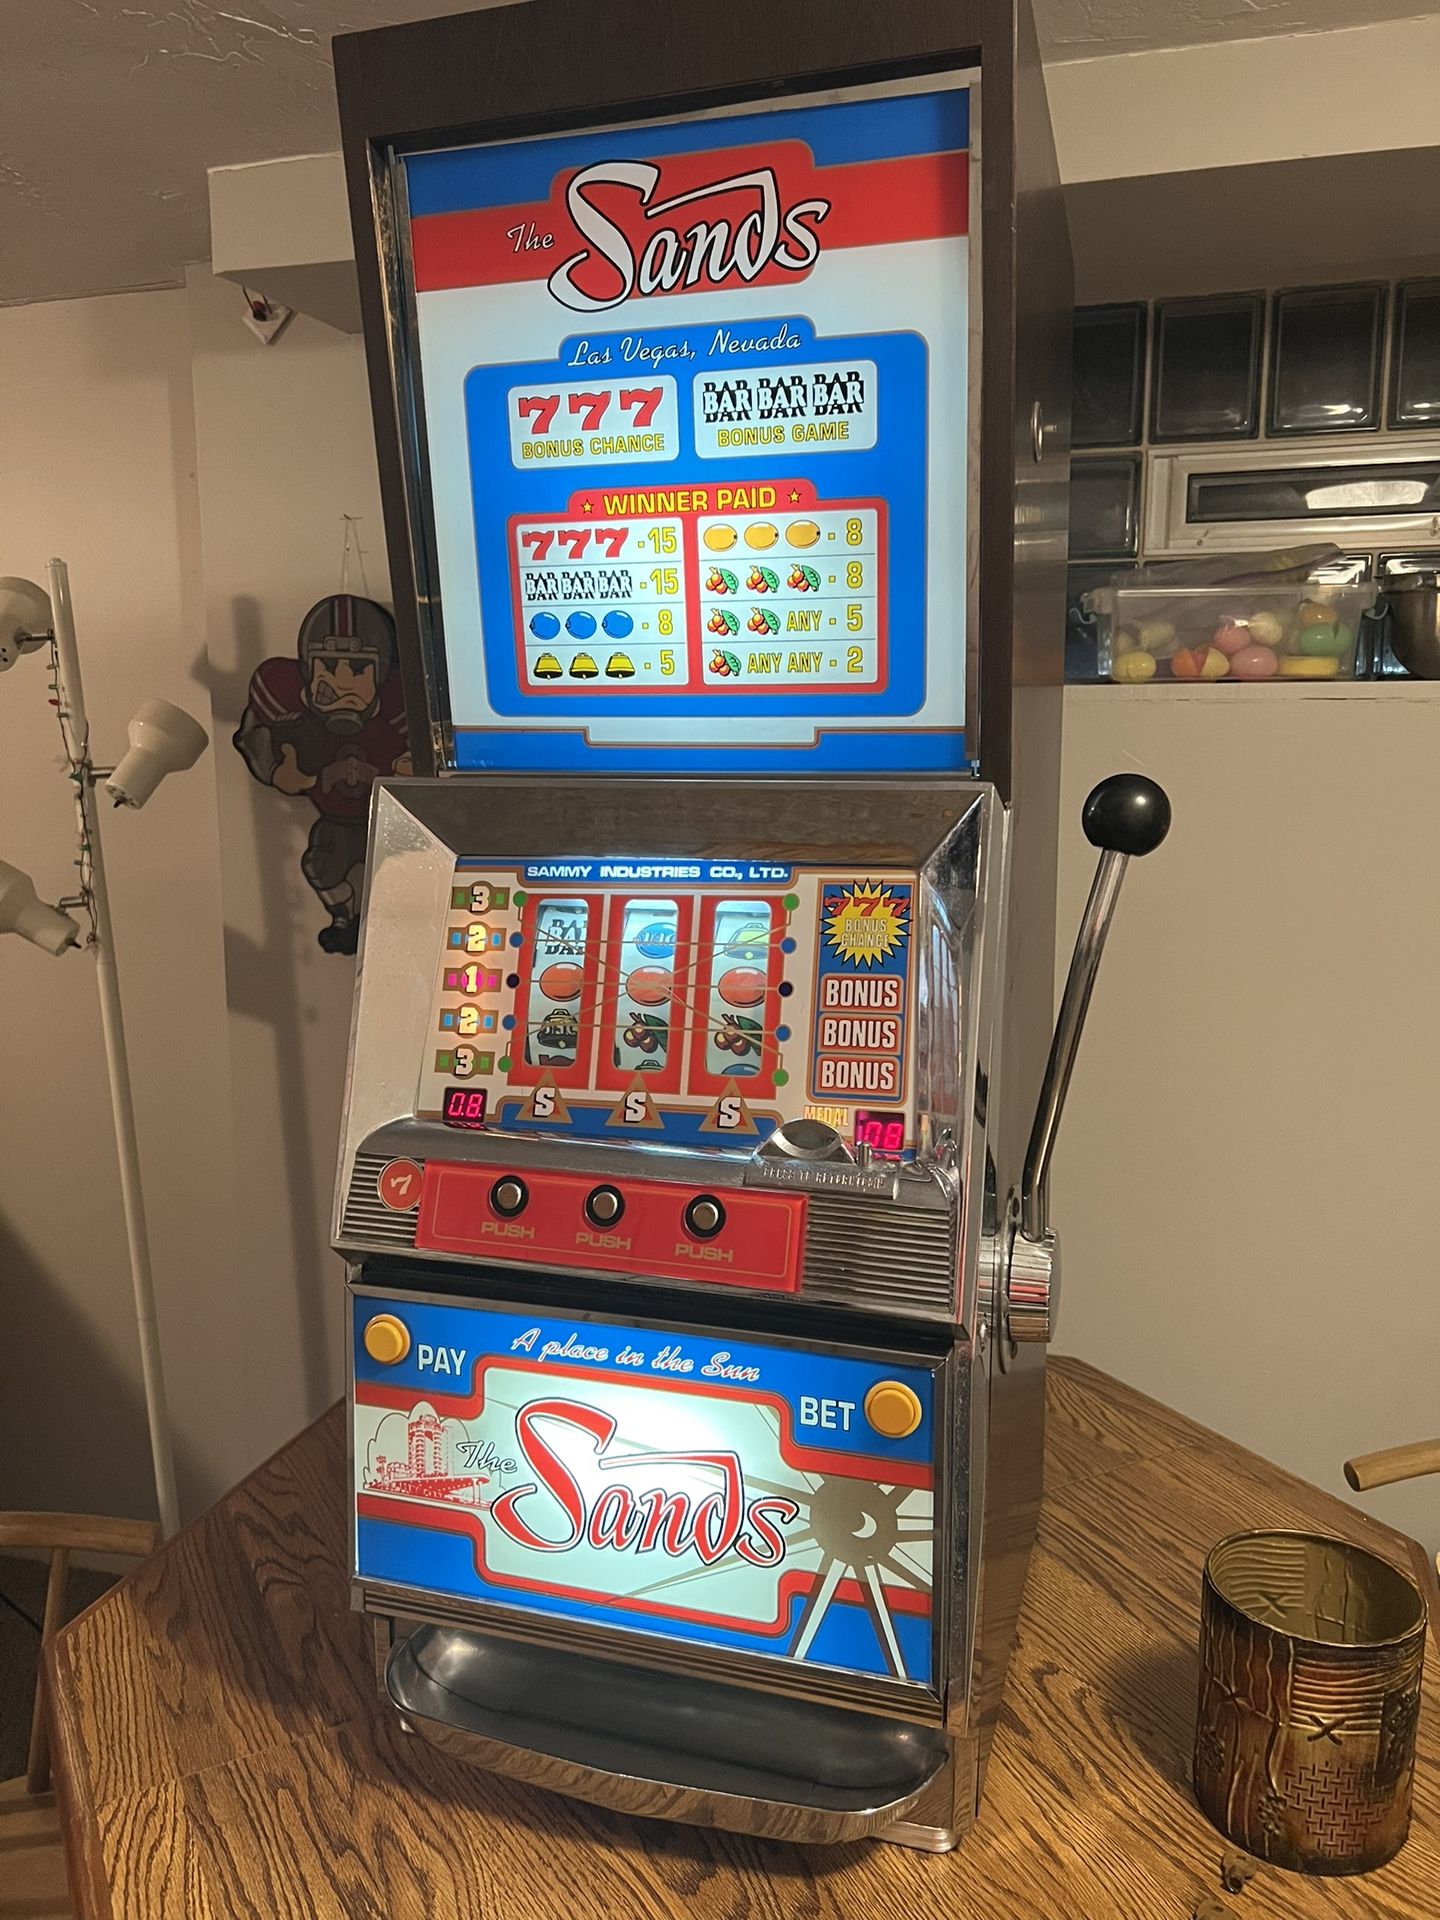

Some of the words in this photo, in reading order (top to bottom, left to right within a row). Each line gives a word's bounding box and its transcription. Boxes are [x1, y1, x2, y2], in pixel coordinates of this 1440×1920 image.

[507, 223, 554, 253] The
[547, 160, 831, 312] Sands
[567, 339, 613, 367] Las
[620, 335, 697, 368] Vegas,
[708, 324, 801, 357] Nevada
[703, 385, 752, 415] BAR
[757, 380, 808, 412] BAR
[812, 377, 865, 409] BAR
[521, 439, 584, 459] BONUS
[590, 433, 665, 455] CHANCE
[717, 426, 785, 447] BONUS
[791, 421, 849, 442] GAME
[603, 490, 708, 515] WINNER
[717, 486, 776, 510] PAID
[846, 518, 863, 546] 8
[847, 561, 863, 589] 8
[658, 609, 673, 635] 8
[786, 610, 822, 631] ANY
[847, 604, 863, 631] 5
[660, 650, 675, 676] 5
[747, 653, 782, 673] ANY
[787, 652, 823, 672] ANY
[847, 646, 863, 673] 2
[527, 866, 592, 878] SAMMY
[600, 866, 700, 878] INDUSTRIES
[749, 866, 788, 878] LTD.
[471, 885, 490, 913] 3
[466, 924, 486, 952] 2
[845, 918, 887, 933] BONUS
[841, 933, 888, 948] CHANCE
[465, 965, 478, 993] 1
[826, 979, 897, 1007] BONUS
[459, 1007, 479, 1035] 2
[824, 1019, 895, 1048] BONUS
[455, 1048, 474, 1076] 3
[821, 1060, 894, 1090] BONUS
[533, 1087, 555, 1117] S
[624, 1092, 646, 1123] S
[717, 1097, 741, 1129] S
[804, 1106, 848, 1126] MEDAL
[391, 1174, 412, 1195] 7
[481, 1221, 535, 1239] PUSH
[576, 1232, 631, 1250] PUSH
[675, 1243, 733, 1263] PUSH
[417, 1343, 466, 1376] PAY
[511, 1328, 541, 1351] A
[538, 1333, 609, 1362] place
[615, 1346, 644, 1366] in
[651, 1346, 694, 1373] the
[701, 1352, 761, 1382] Sun
[799, 1397, 855, 1431] BET
[456, 1440, 518, 1474] The
[491, 1397, 799, 1568] Sands
